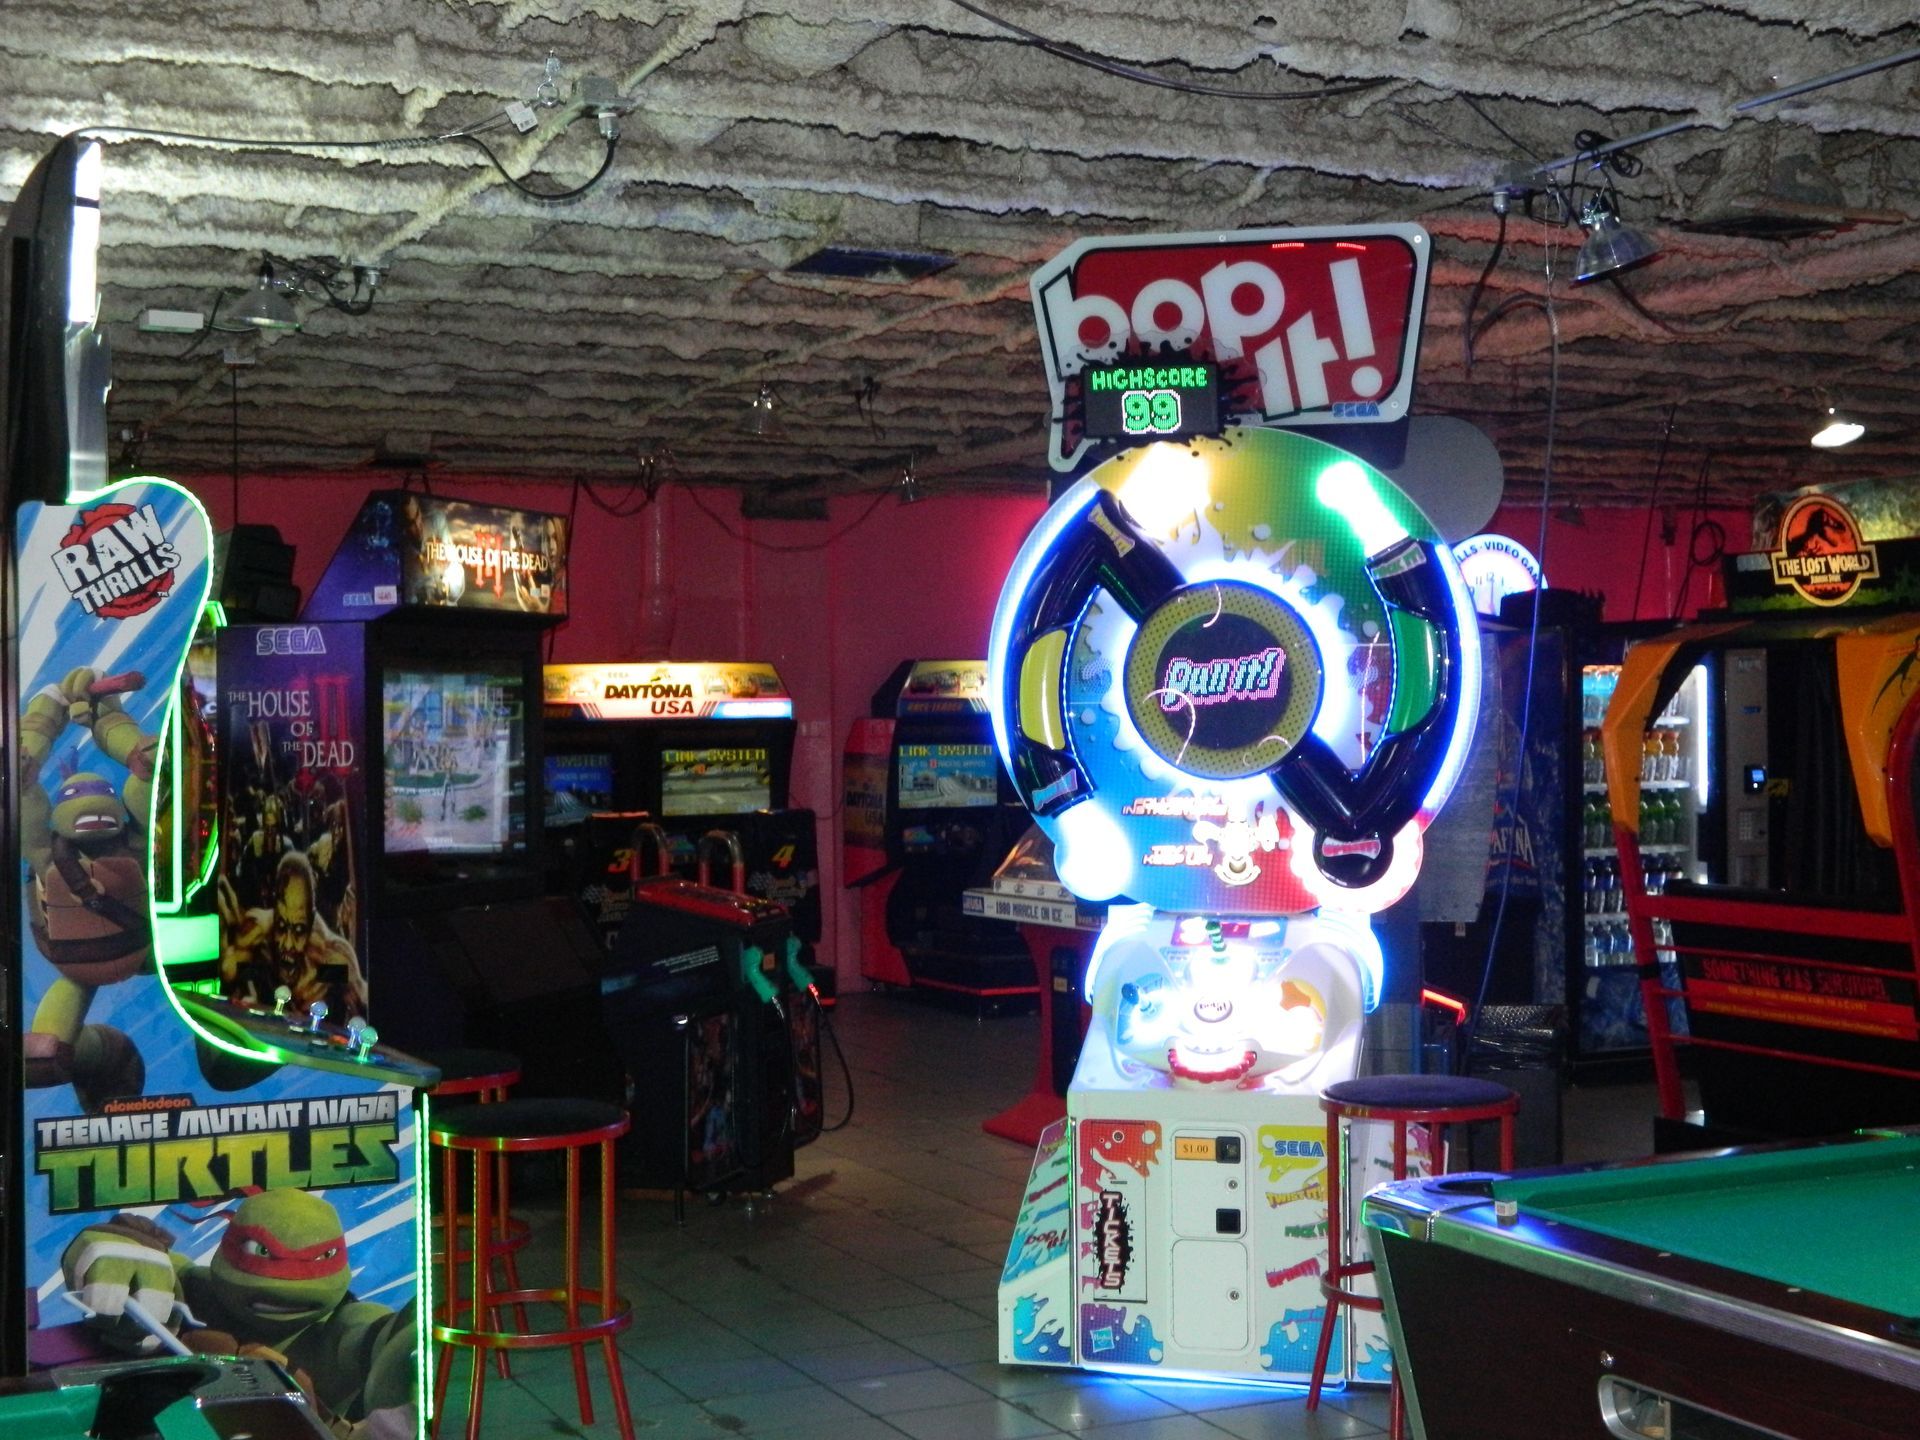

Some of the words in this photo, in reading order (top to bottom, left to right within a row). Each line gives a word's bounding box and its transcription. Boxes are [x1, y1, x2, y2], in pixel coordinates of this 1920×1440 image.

[1092, 366, 1208, 391] HIGHSCORE
[1121, 390, 1182, 434] 99
[51, 504, 166, 593] RAW
[1484, 541, 1520, 559] VIDEO
[500, 550, 521, 573] THE
[521, 553, 549, 572] DEAD
[1779, 558, 1801, 576] THE
[1801, 555, 1827, 576] LOST
[1827, 554, 1871, 574] WORLD
[72, 542, 182, 614] THRILLS
[256, 626, 327, 655] SEGA
[604, 684, 694, 699] DAYTONA
[227, 691, 248, 704] THE
[248, 691, 312, 718] HOUSE
[651, 700, 695, 714] USA
[290, 726, 314, 743] OF
[282, 741, 303, 754] THE
[303, 742, 355, 769] DEAD
[608, 848, 636, 873] 3
[772, 845, 796, 869] 4
[104, 1097, 191, 1113] nickelodeon
[37, 1113, 169, 1148] TEENAGE
[178, 1103, 304, 1136] MUTANT
[310, 1094, 398, 1126] NINJA
[1182, 1144, 1209, 1154] $1.00
[1274, 1140, 1324, 1157] SEGA
[38, 1124, 397, 1212] TURTLES
[1101, 1193, 1123, 1288] TICKETS
